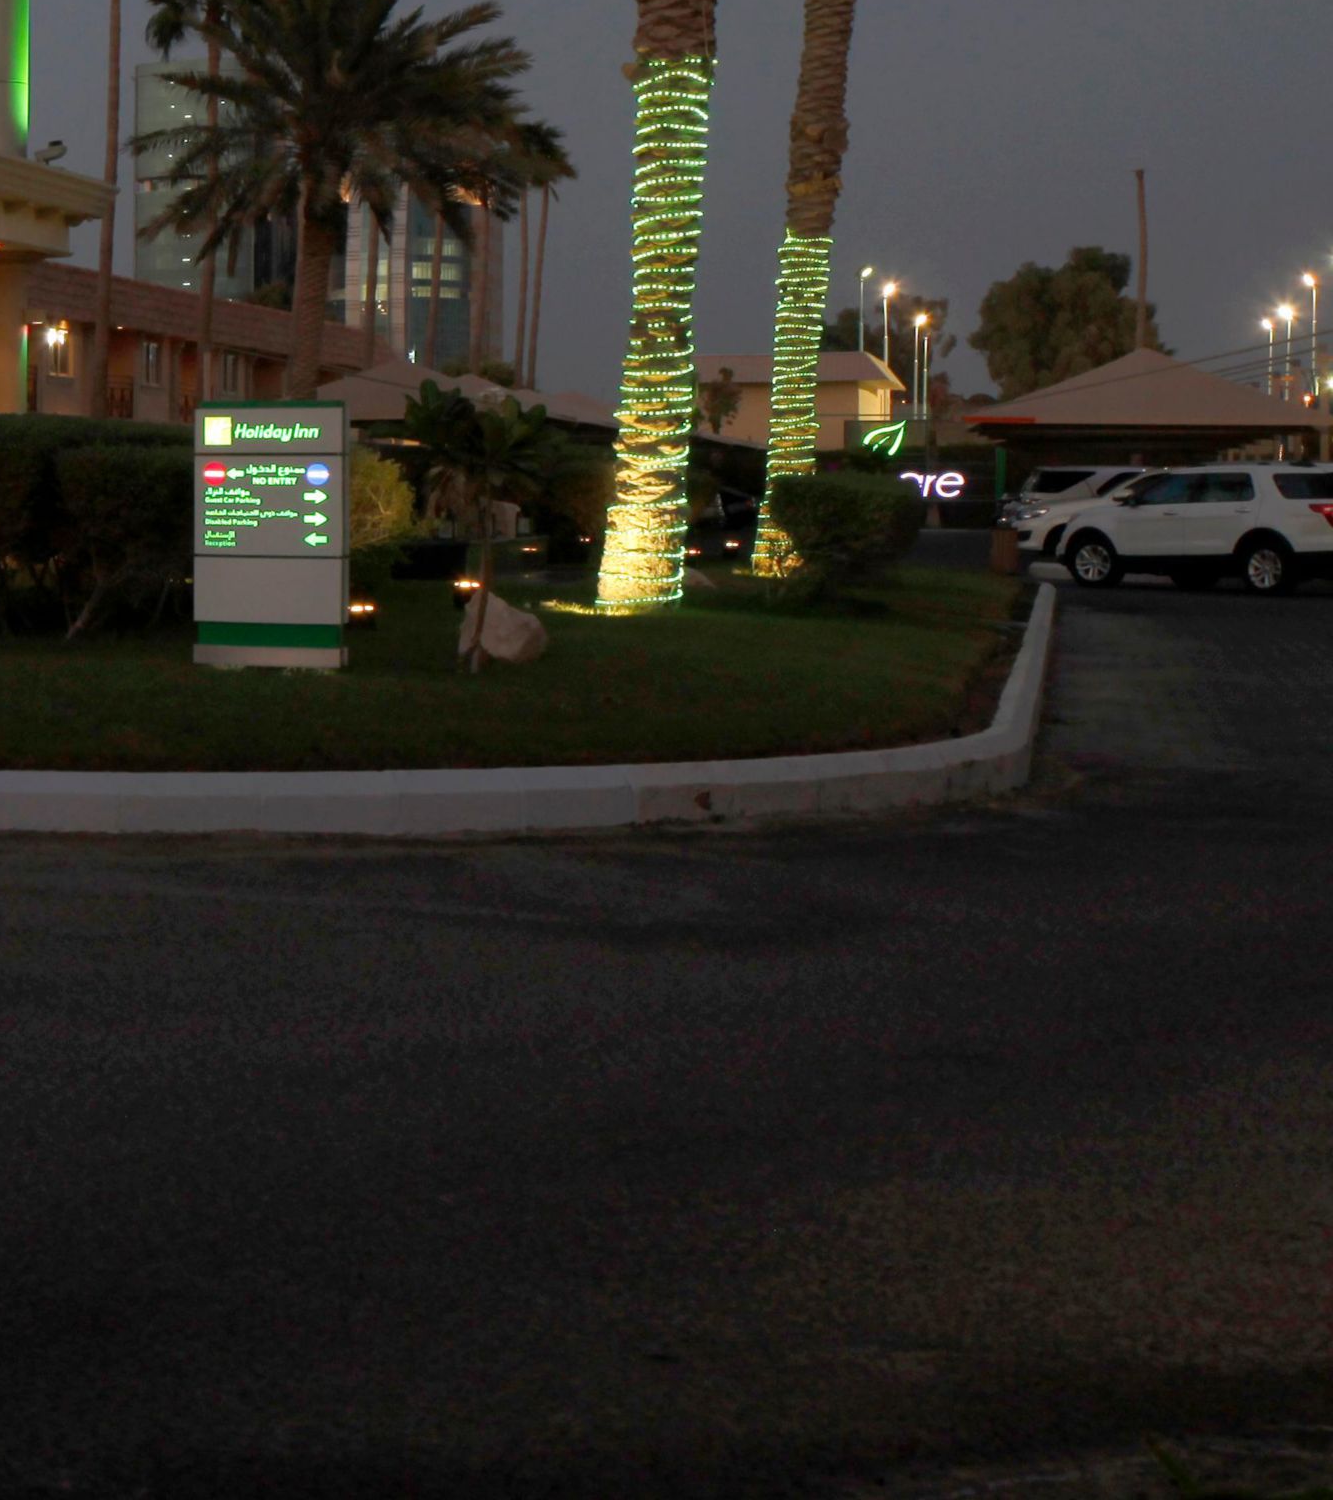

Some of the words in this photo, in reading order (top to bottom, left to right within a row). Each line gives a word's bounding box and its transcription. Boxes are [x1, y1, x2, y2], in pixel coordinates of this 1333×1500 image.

[234, 423, 293, 443] Holiday
[293, 423, 320, 439] Inn
[245, 464, 277, 476] الدخول
[252, 476, 267, 485] NO
[267, 476, 298, 485] ENTRY
[223, 496, 234, 504] Car
[235, 497, 261, 506] Parking
[232, 518, 259, 527] Parking
